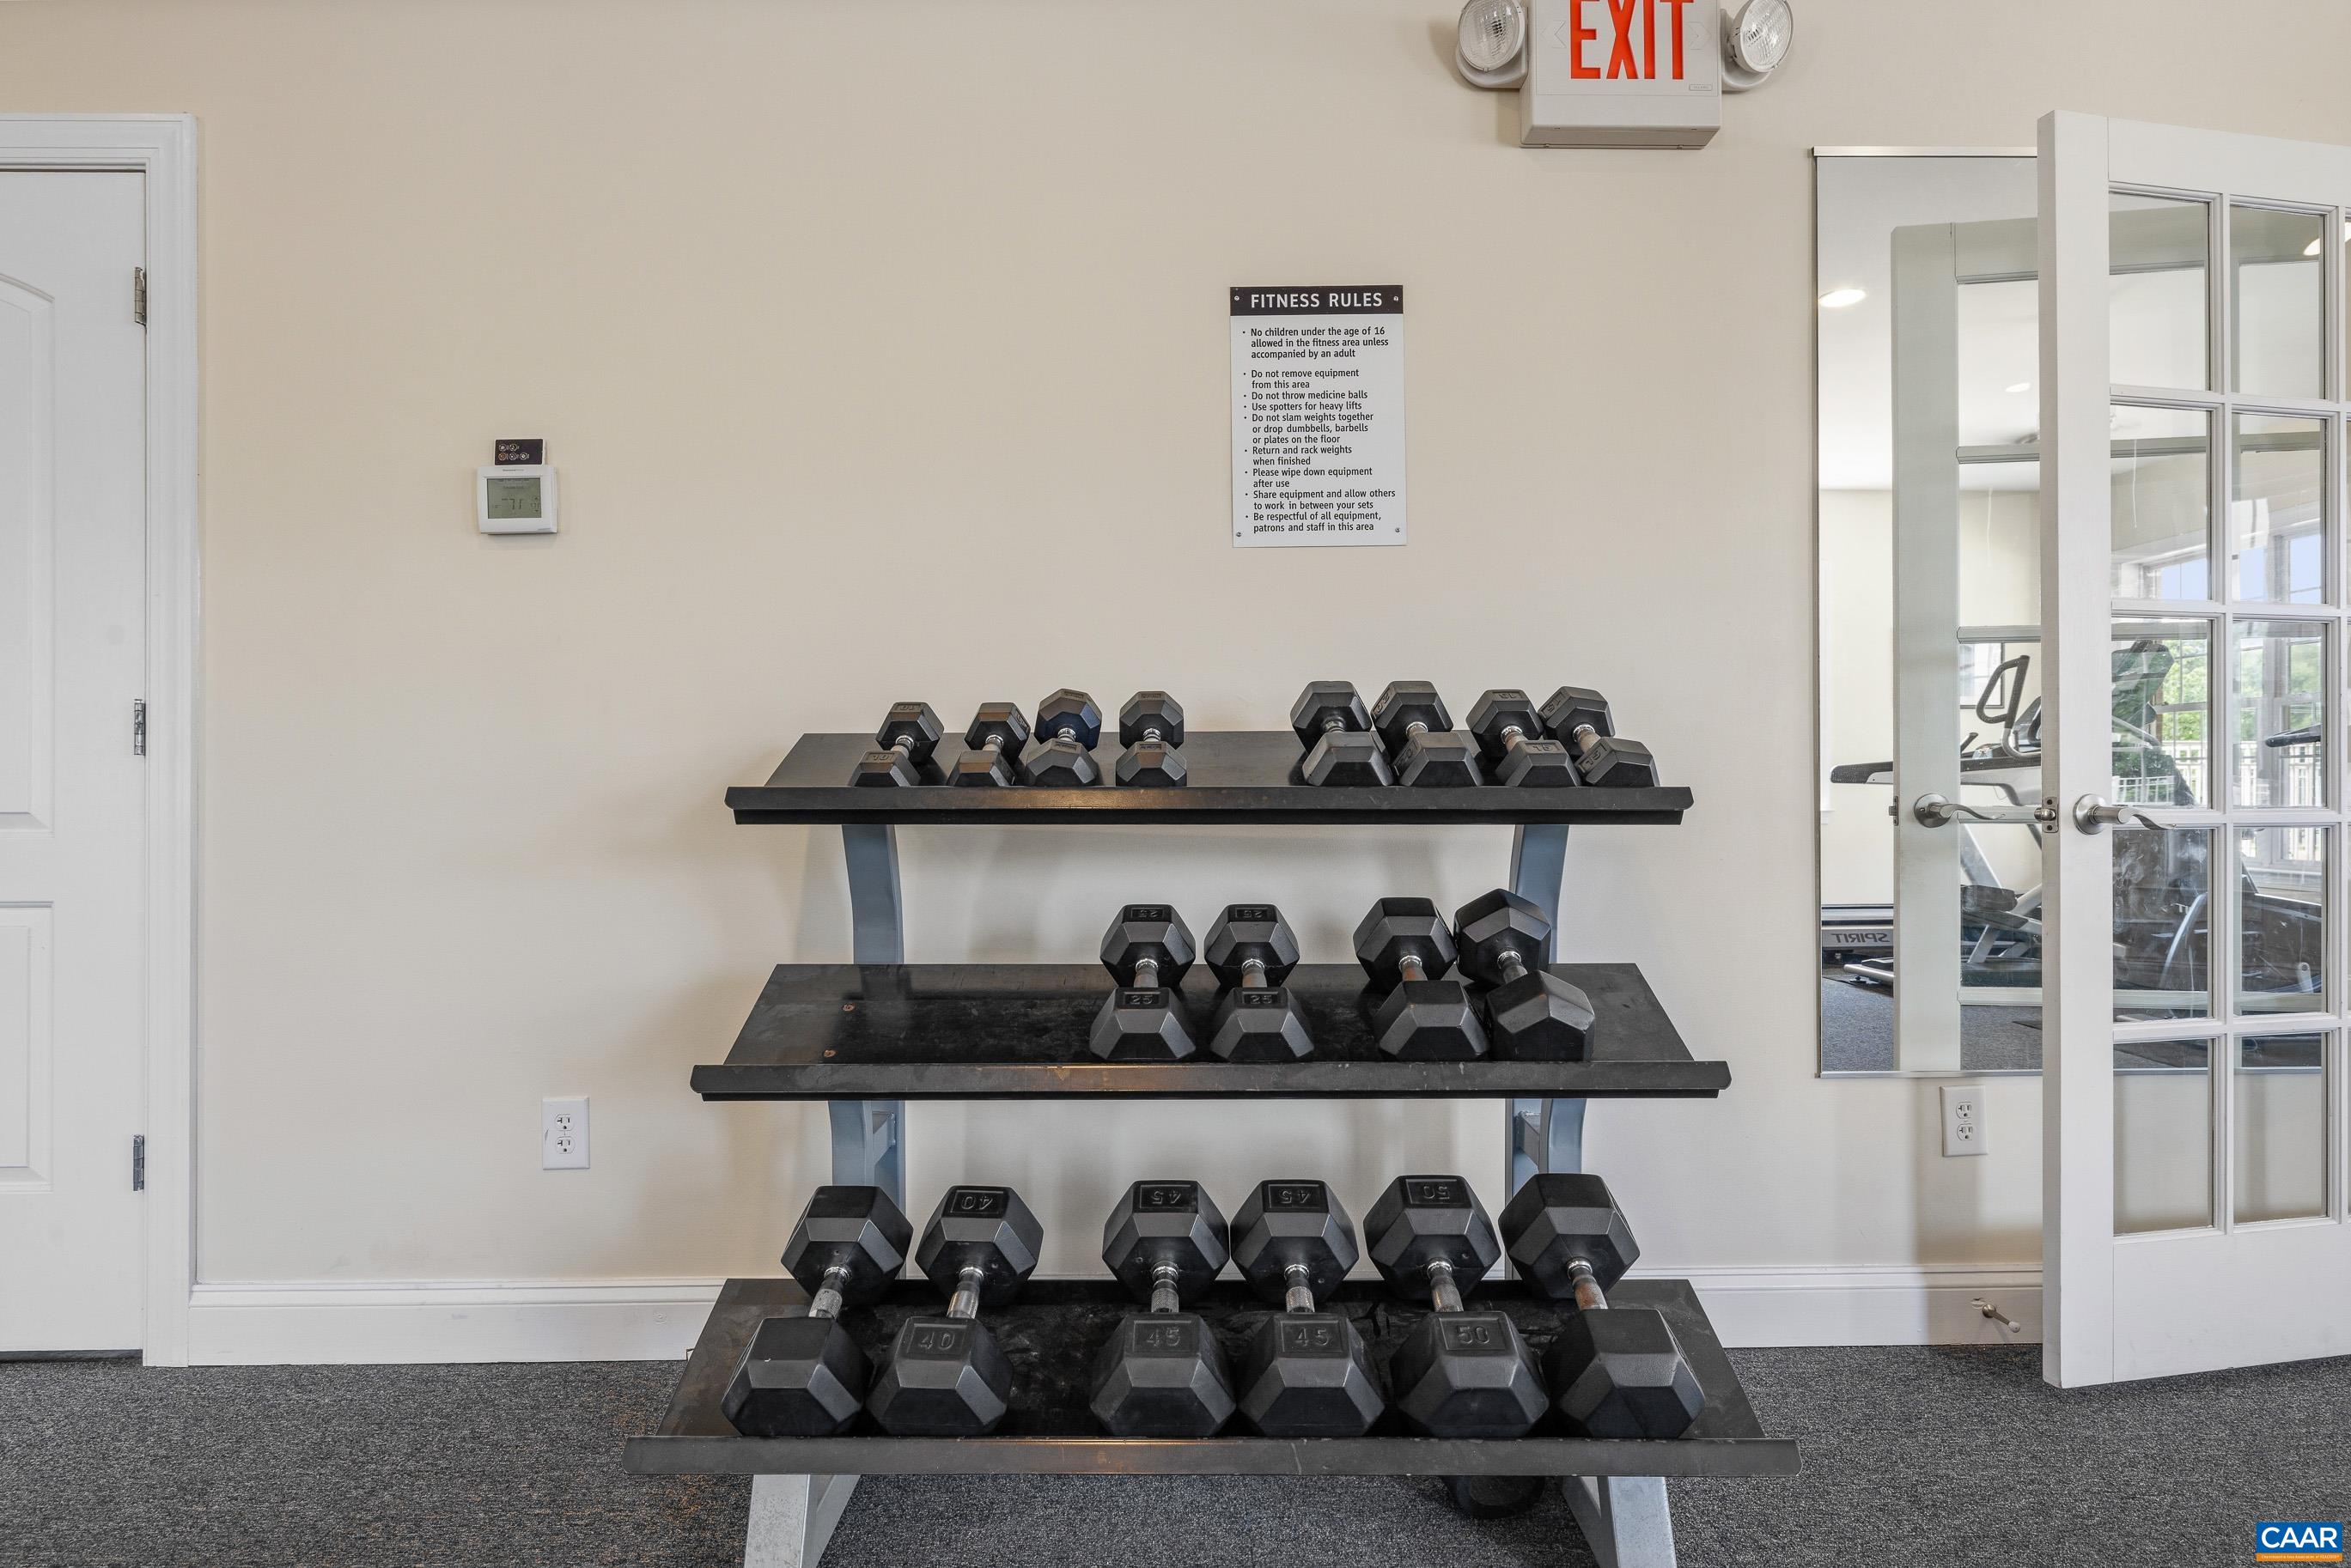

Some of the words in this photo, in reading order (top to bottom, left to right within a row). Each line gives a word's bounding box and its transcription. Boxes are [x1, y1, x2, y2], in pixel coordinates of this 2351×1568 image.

[1570, 0, 1694, 79] EXIT
[1251, 294, 1320, 307] FITNESS
[1329, 293, 1382, 307] RULES
[1251, 328, 1263, 337] No
[1264, 327, 1299, 337] children
[1301, 327, 1325, 336] under
[1327, 326, 1342, 336] the
[1343, 328, 1360, 337] age
[1361, 326, 1371, 336] of
[1374, 326, 1386, 335] 16
[1251, 338, 1283, 348] allowed
[1285, 338, 1294, 347] in
[1296, 338, 1310, 347] the
[1312, 337, 1340, 347] fitness
[1362, 337, 1389, 346] unless
[1251, 349, 1306, 360] accompanied
[1308, 349, 1319, 359] by
[1333, 349, 1355, 357] adult
[1251, 369, 1263, 378] Do
[1314, 368, 1359, 379] equipment
[1252, 380, 1271, 389] from
[1274, 380, 1289, 389] this
[1252, 392, 1264, 400] Do
[1265, 392, 1280, 400] not
[1282, 391, 1306, 399] throw
[1307, 390, 1346, 399] medicine
[1348, 390, 1368, 399] balls
[1252, 403, 1267, 411] Use
[1269, 403, 1302, 412] spotters
[1304, 401, 1317, 410] for
[1319, 401, 1343, 412] heavy
[1346, 401, 1362, 410] lifts
[1252, 413, 1264, 422] Do
[1282, 413, 1301, 422] slam
[1304, 412, 1336, 423] weights
[1337, 412, 1374, 422] together
[1264, 424, 1283, 435] drop
[1286, 423, 1332, 434] dumbbells,
[1335, 423, 1368, 432] barbells
[1264, 435, 1289, 446] plates
[1304, 435, 1319, 444] the
[1320, 435, 1341, 443] floor
[1252, 446, 1280, 455] Return
[1282, 446, 1298, 454] and
[1300, 446, 1319, 454] rack
[1320, 445, 1352, 456] weights
[1252, 457, 1275, 465] when
[1277, 456, 1311, 465] finished
[1252, 468, 1279, 477] Please
[1281, 467, 1301, 478] wipe
[1303, 467, 1325, 476] down
[1328, 466, 1373, 477] equipment
[1253, 478, 1273, 488] after
[1253, 489, 1277, 499] Share
[1279, 489, 1325, 500] equipment
[1326, 489, 1342, 498] and
[1344, 489, 1367, 498] allow
[1369, 489, 1396, 497] others
[1264, 501, 1285, 510] work
[1288, 501, 1297, 510] in
[1300, 501, 1334, 509] between
[1336, 502, 1355, 511] your
[1357, 501, 1373, 509] sets
[1253, 512, 1264, 521] Be
[1266, 512, 1307, 522] respectful
[1309, 511, 1319, 520] of
[1320, 511, 1331, 520] all
[1333, 511, 1381, 521] equipment,
[1253, 524, 1285, 533] patrons
[1288, 523, 1304, 532] and
[1306, 522, 1325, 532] staff
[1327, 522, 1336, 531] in
[1338, 522, 1354, 531] this
[1138, 909, 1160, 918] 25
[1244, 909, 1263, 918] 25
[1130, 994, 1153, 1005] 25
[1250, 994, 1273, 1004] 25
[1149, 1189, 1182, 1205] 45
[1279, 1189, 1313, 1205] 45
[1422, 1184, 1451, 1200] 50
[960, 1195, 994, 1210] 40
[1146, 1327, 1180, 1347] 45
[1294, 1327, 1330, 1347] 45
[1455, 1325, 1489, 1344] 50
[918, 1332, 955, 1351] 40
